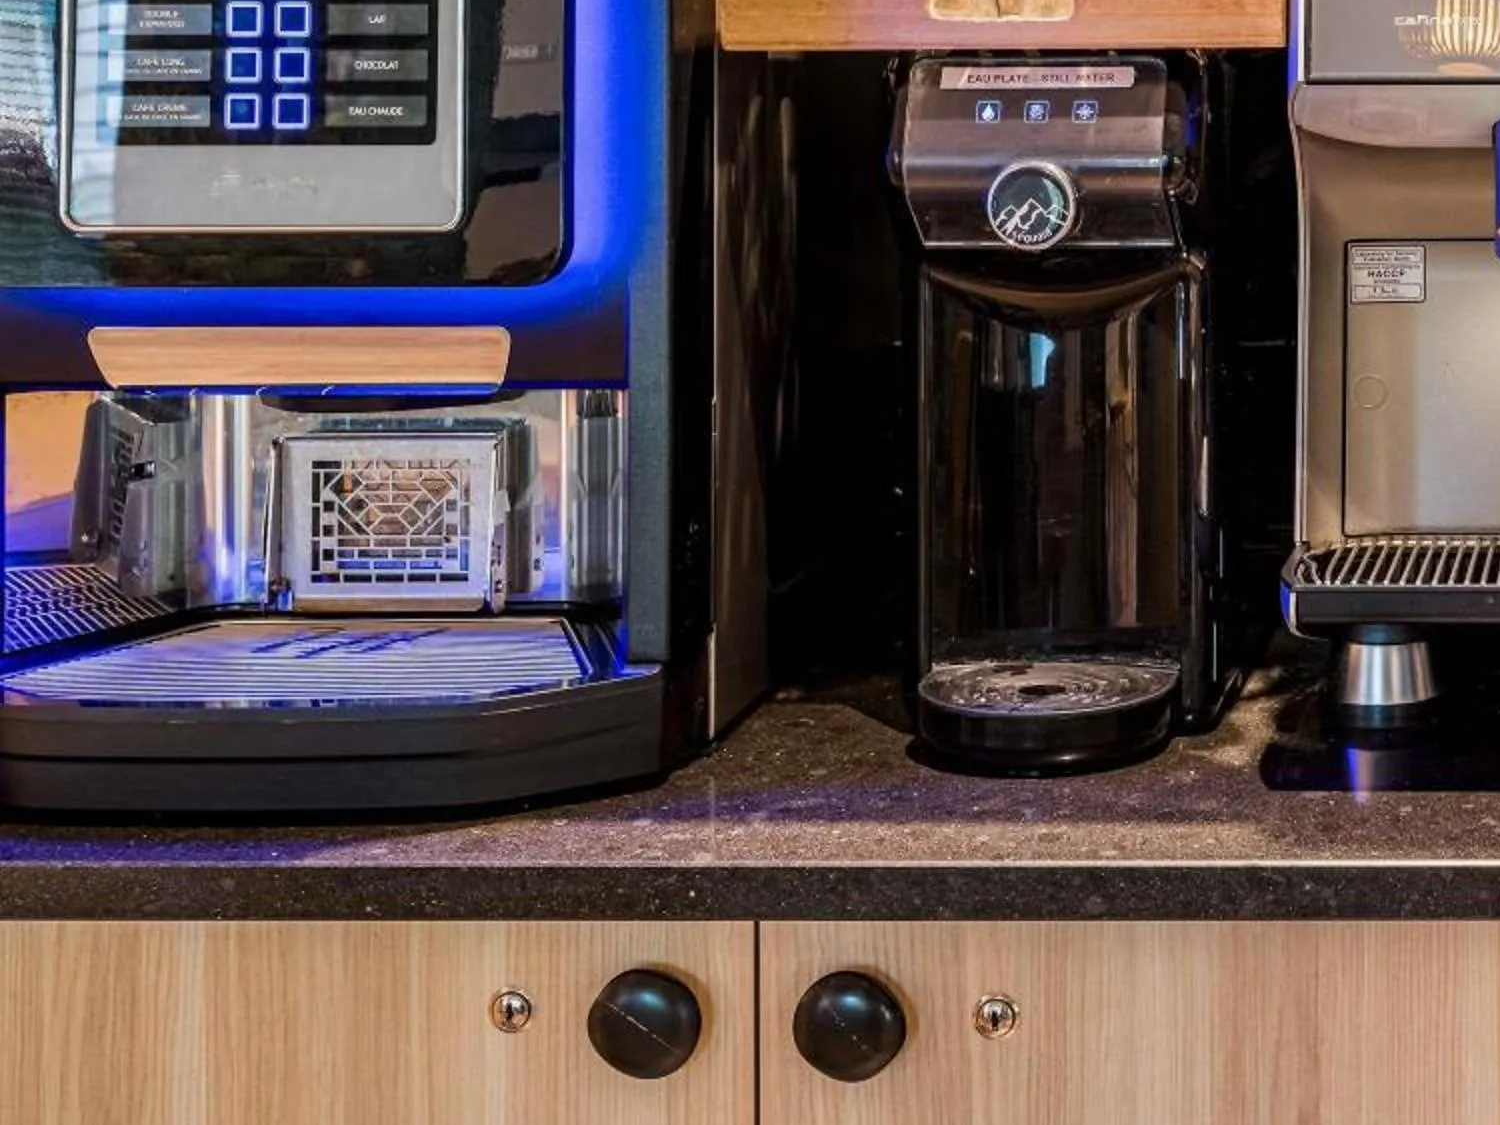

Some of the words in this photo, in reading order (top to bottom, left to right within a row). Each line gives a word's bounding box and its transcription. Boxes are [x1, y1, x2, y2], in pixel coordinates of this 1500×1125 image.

[354, 60, 399, 70] CHOCOLAT
[967, 75, 990, 83] EAU
[348, 106, 366, 116] EAU
[367, 106, 404, 116] CHAUDE
